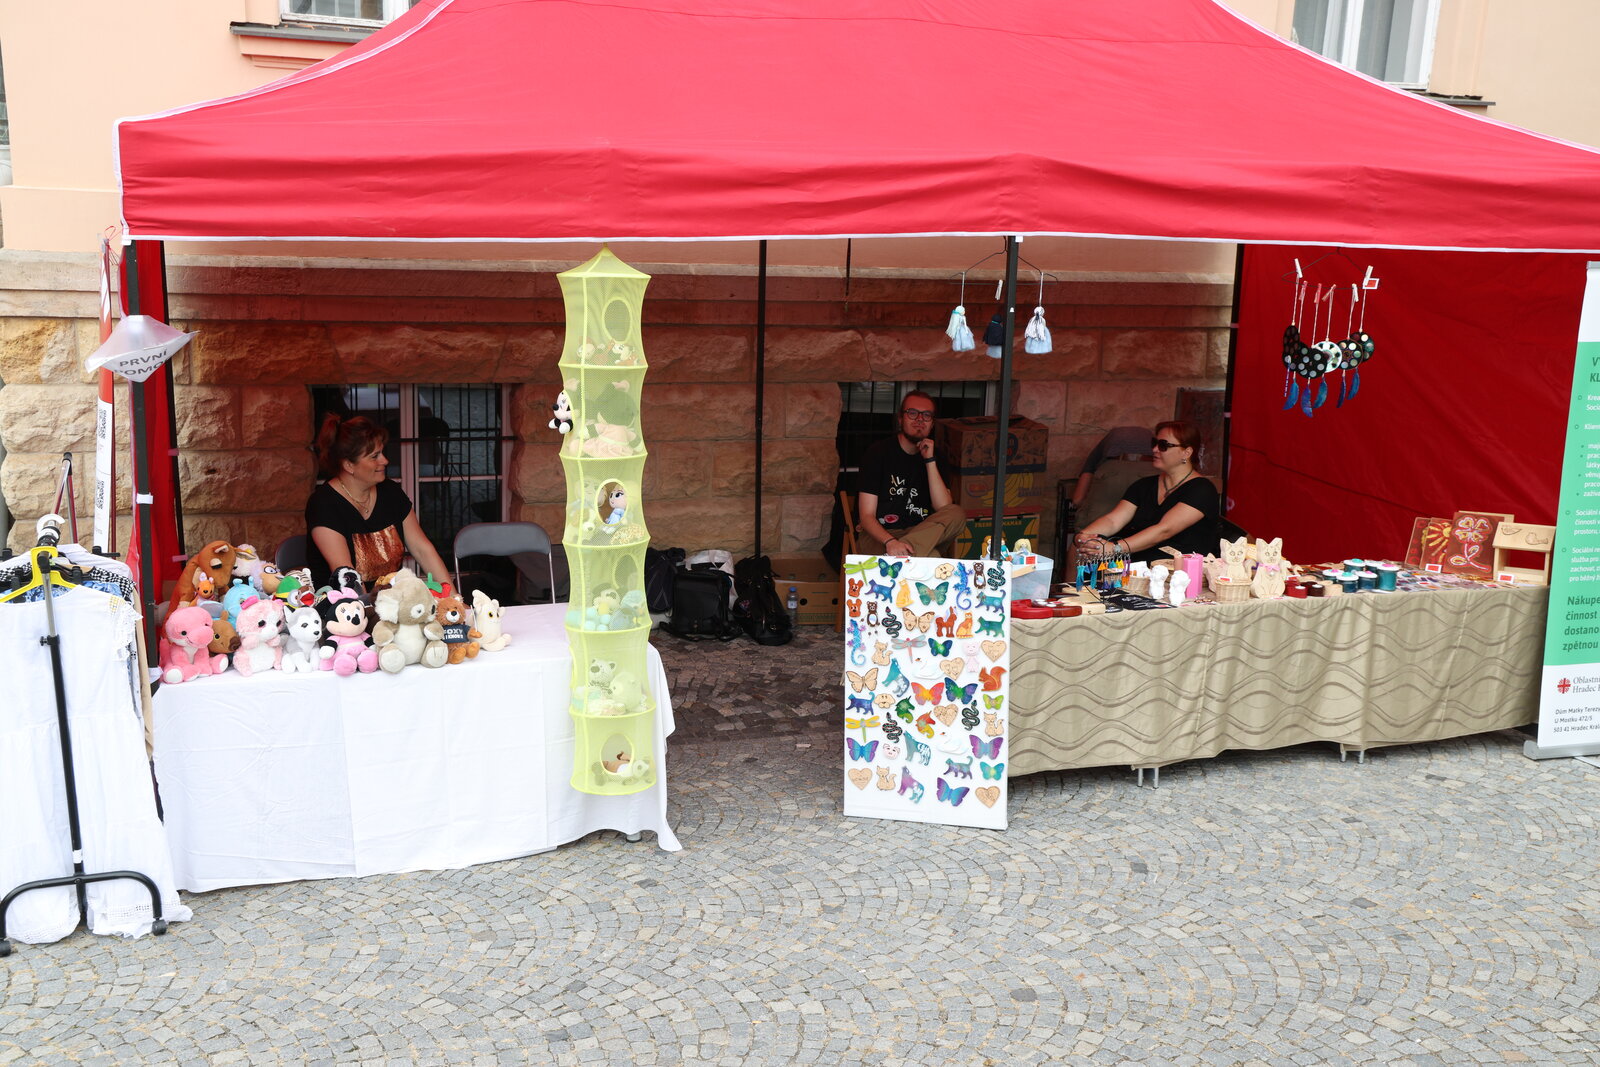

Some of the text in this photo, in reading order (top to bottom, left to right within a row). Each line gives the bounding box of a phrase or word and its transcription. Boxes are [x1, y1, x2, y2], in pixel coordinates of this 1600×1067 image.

[120, 349, 167, 366] PRVNÍ
[115, 360, 166, 375] OMO
[1566, 610, 1597, 620] činnost
[1562, 640, 1598, 652] zpětnou
